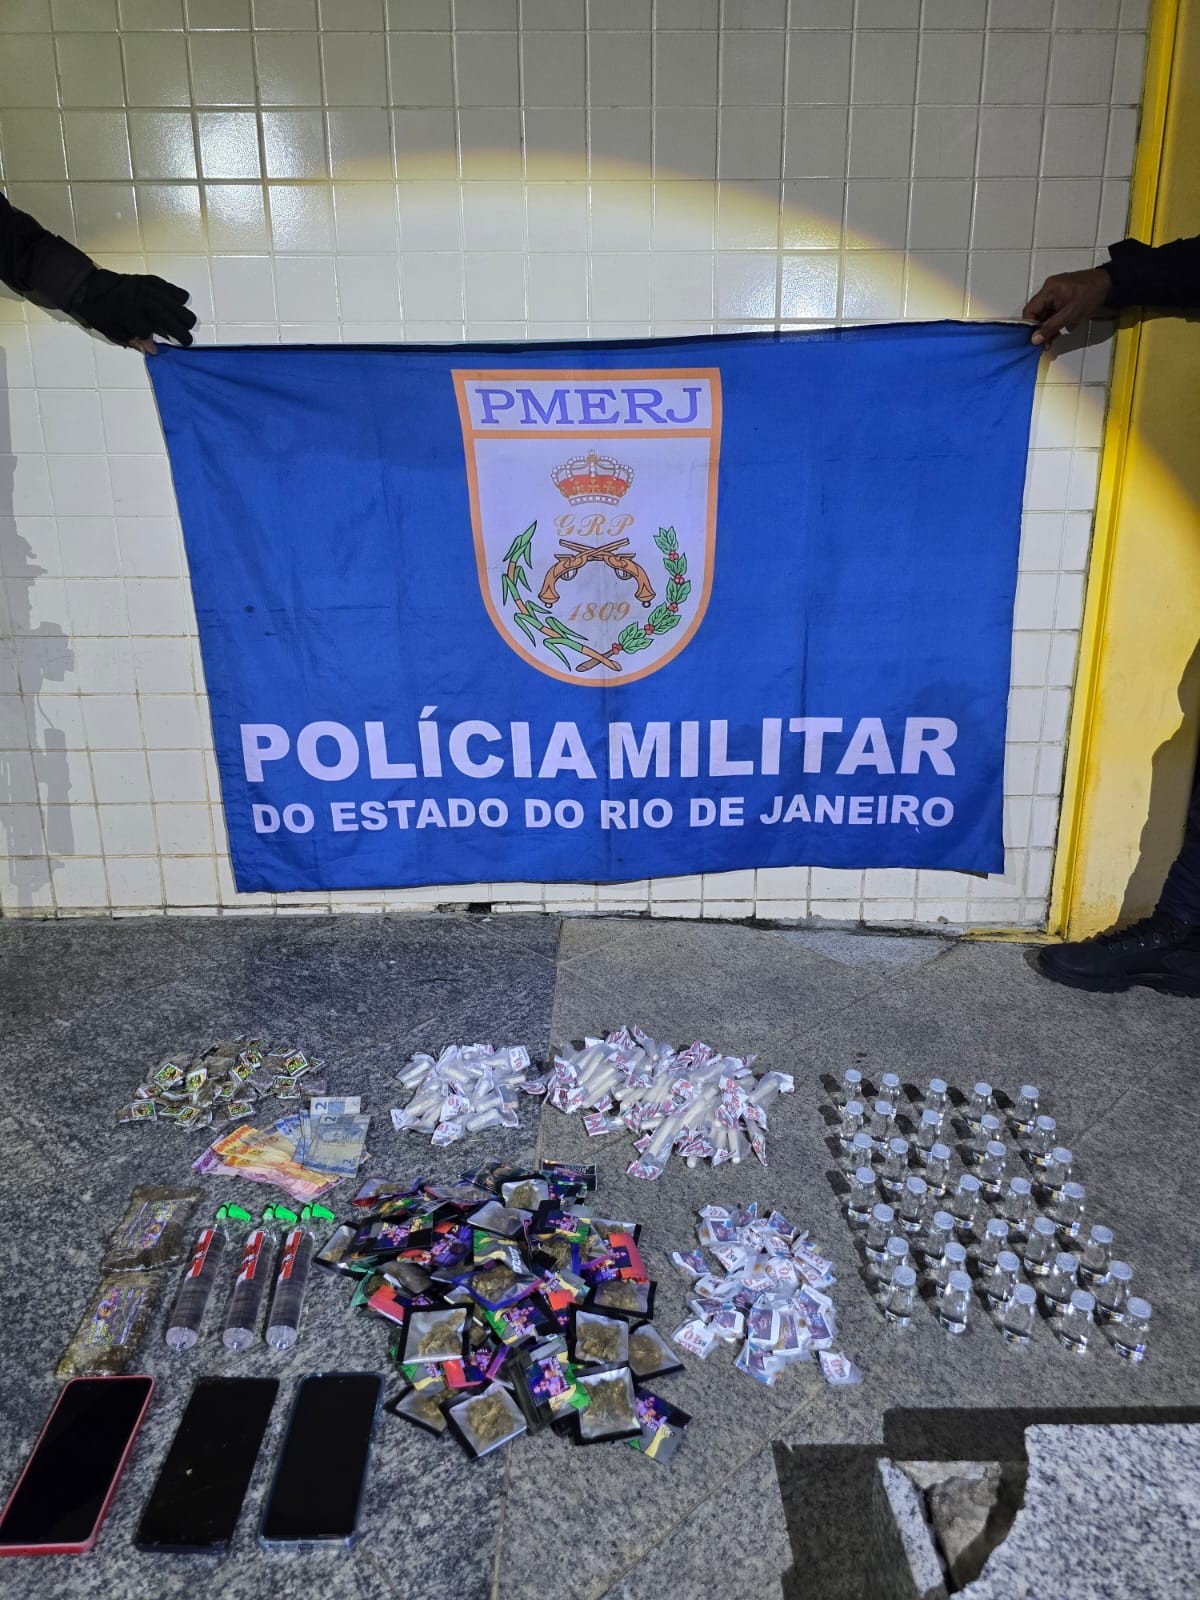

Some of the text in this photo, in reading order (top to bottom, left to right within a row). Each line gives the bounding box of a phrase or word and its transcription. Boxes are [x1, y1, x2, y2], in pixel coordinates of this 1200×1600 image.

[475, 387, 702, 424] PMERJ
[568, 601, 631, 622] 1809
[241, 705, 958, 782] POLÍCIA MILITAR
[252, 794, 954, 834] DO ESTADO DO RIO DE JANEIRO
